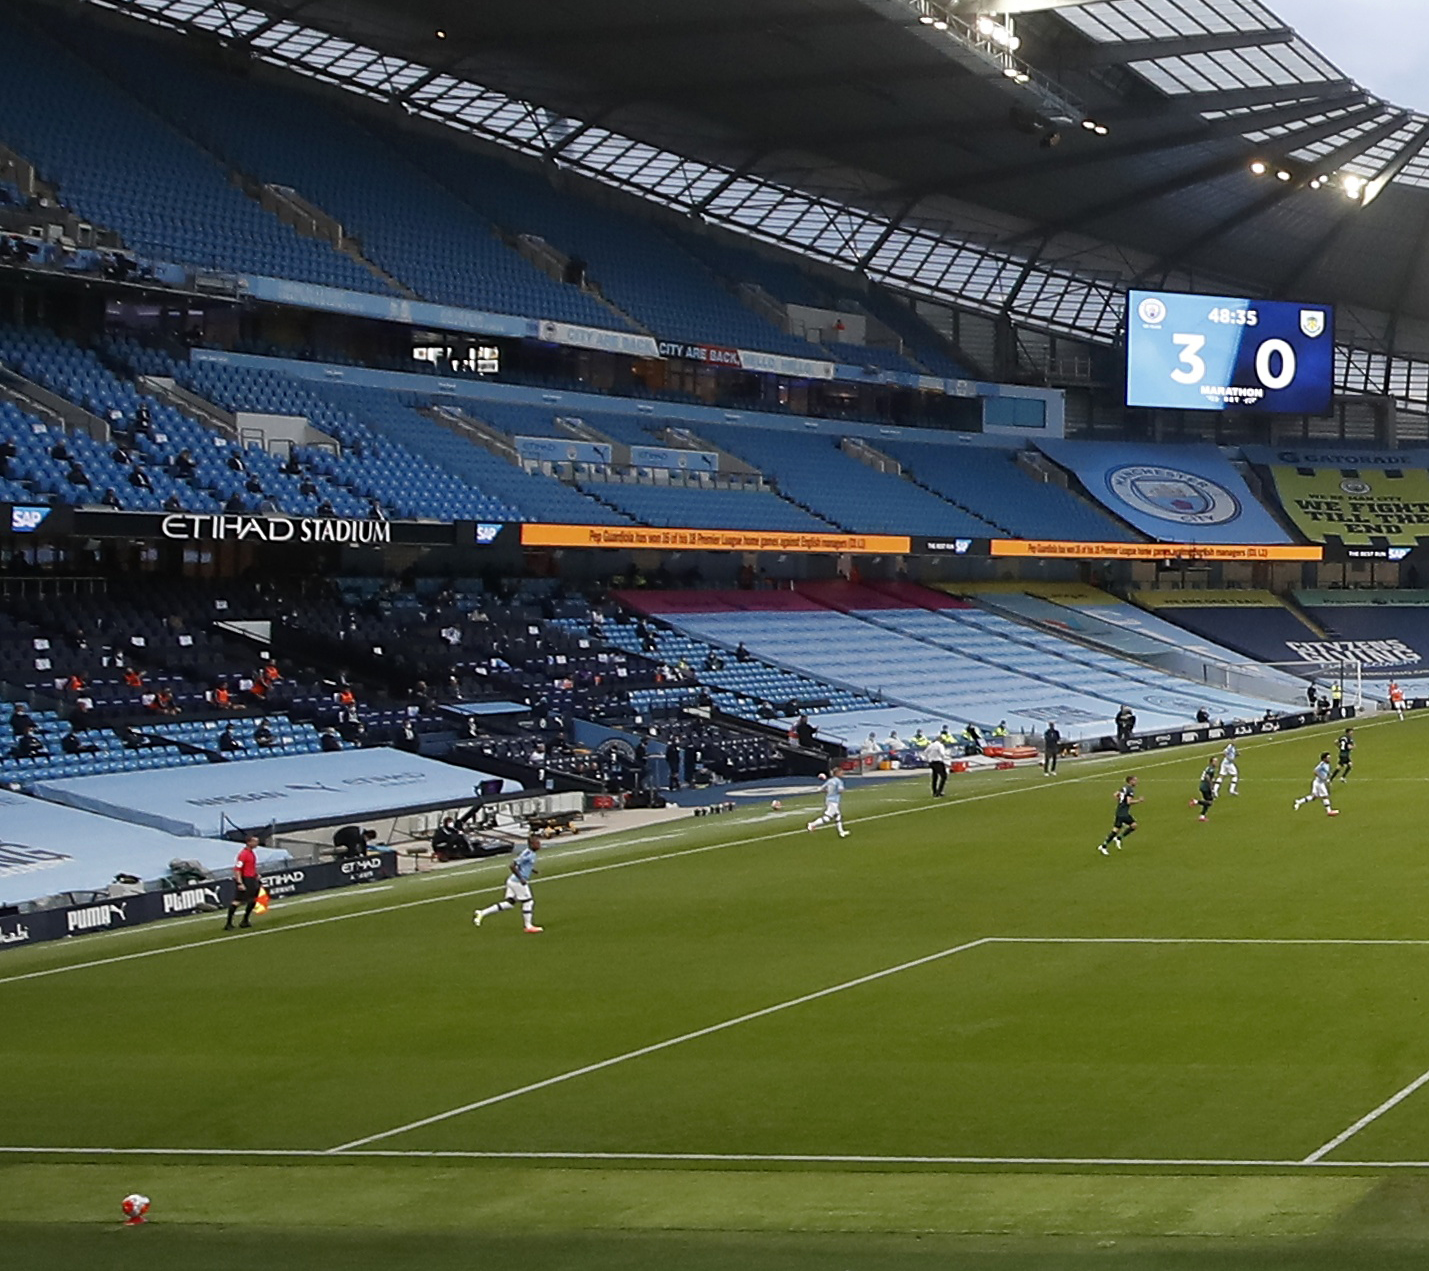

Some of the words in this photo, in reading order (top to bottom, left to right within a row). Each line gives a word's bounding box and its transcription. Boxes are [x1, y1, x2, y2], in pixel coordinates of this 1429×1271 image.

[1208, 307, 1258, 326] 48:35
[659, 342, 684, 357] CITY
[685, 345, 707, 360] ARE
[1170, 333, 1206, 385] 3
[1255, 338, 1296, 389] 0
[1200, 385, 1263, 398] MARATHON
[1304, 452, 1411, 464] GATORADE
[1294, 499, 1342, 512] WE
[12, 510, 41, 528] SAP
[1181, 514, 1215, 523] CITY
[1303, 511, 1370, 523] TILL
[162, 515, 295, 542] ETIHAD
[300, 519, 391, 543] STADIUM
[476, 525, 499, 541] SAP
[1344, 523, 1403, 535] END
[1285, 638, 1409, 652] CITYZENS
[1298, 650, 1422, 663] GIVING
[185, 790, 289, 807] NISSAN
[260, 871, 304, 888] ETIHAD
[67, 907, 111, 931] PUMA
